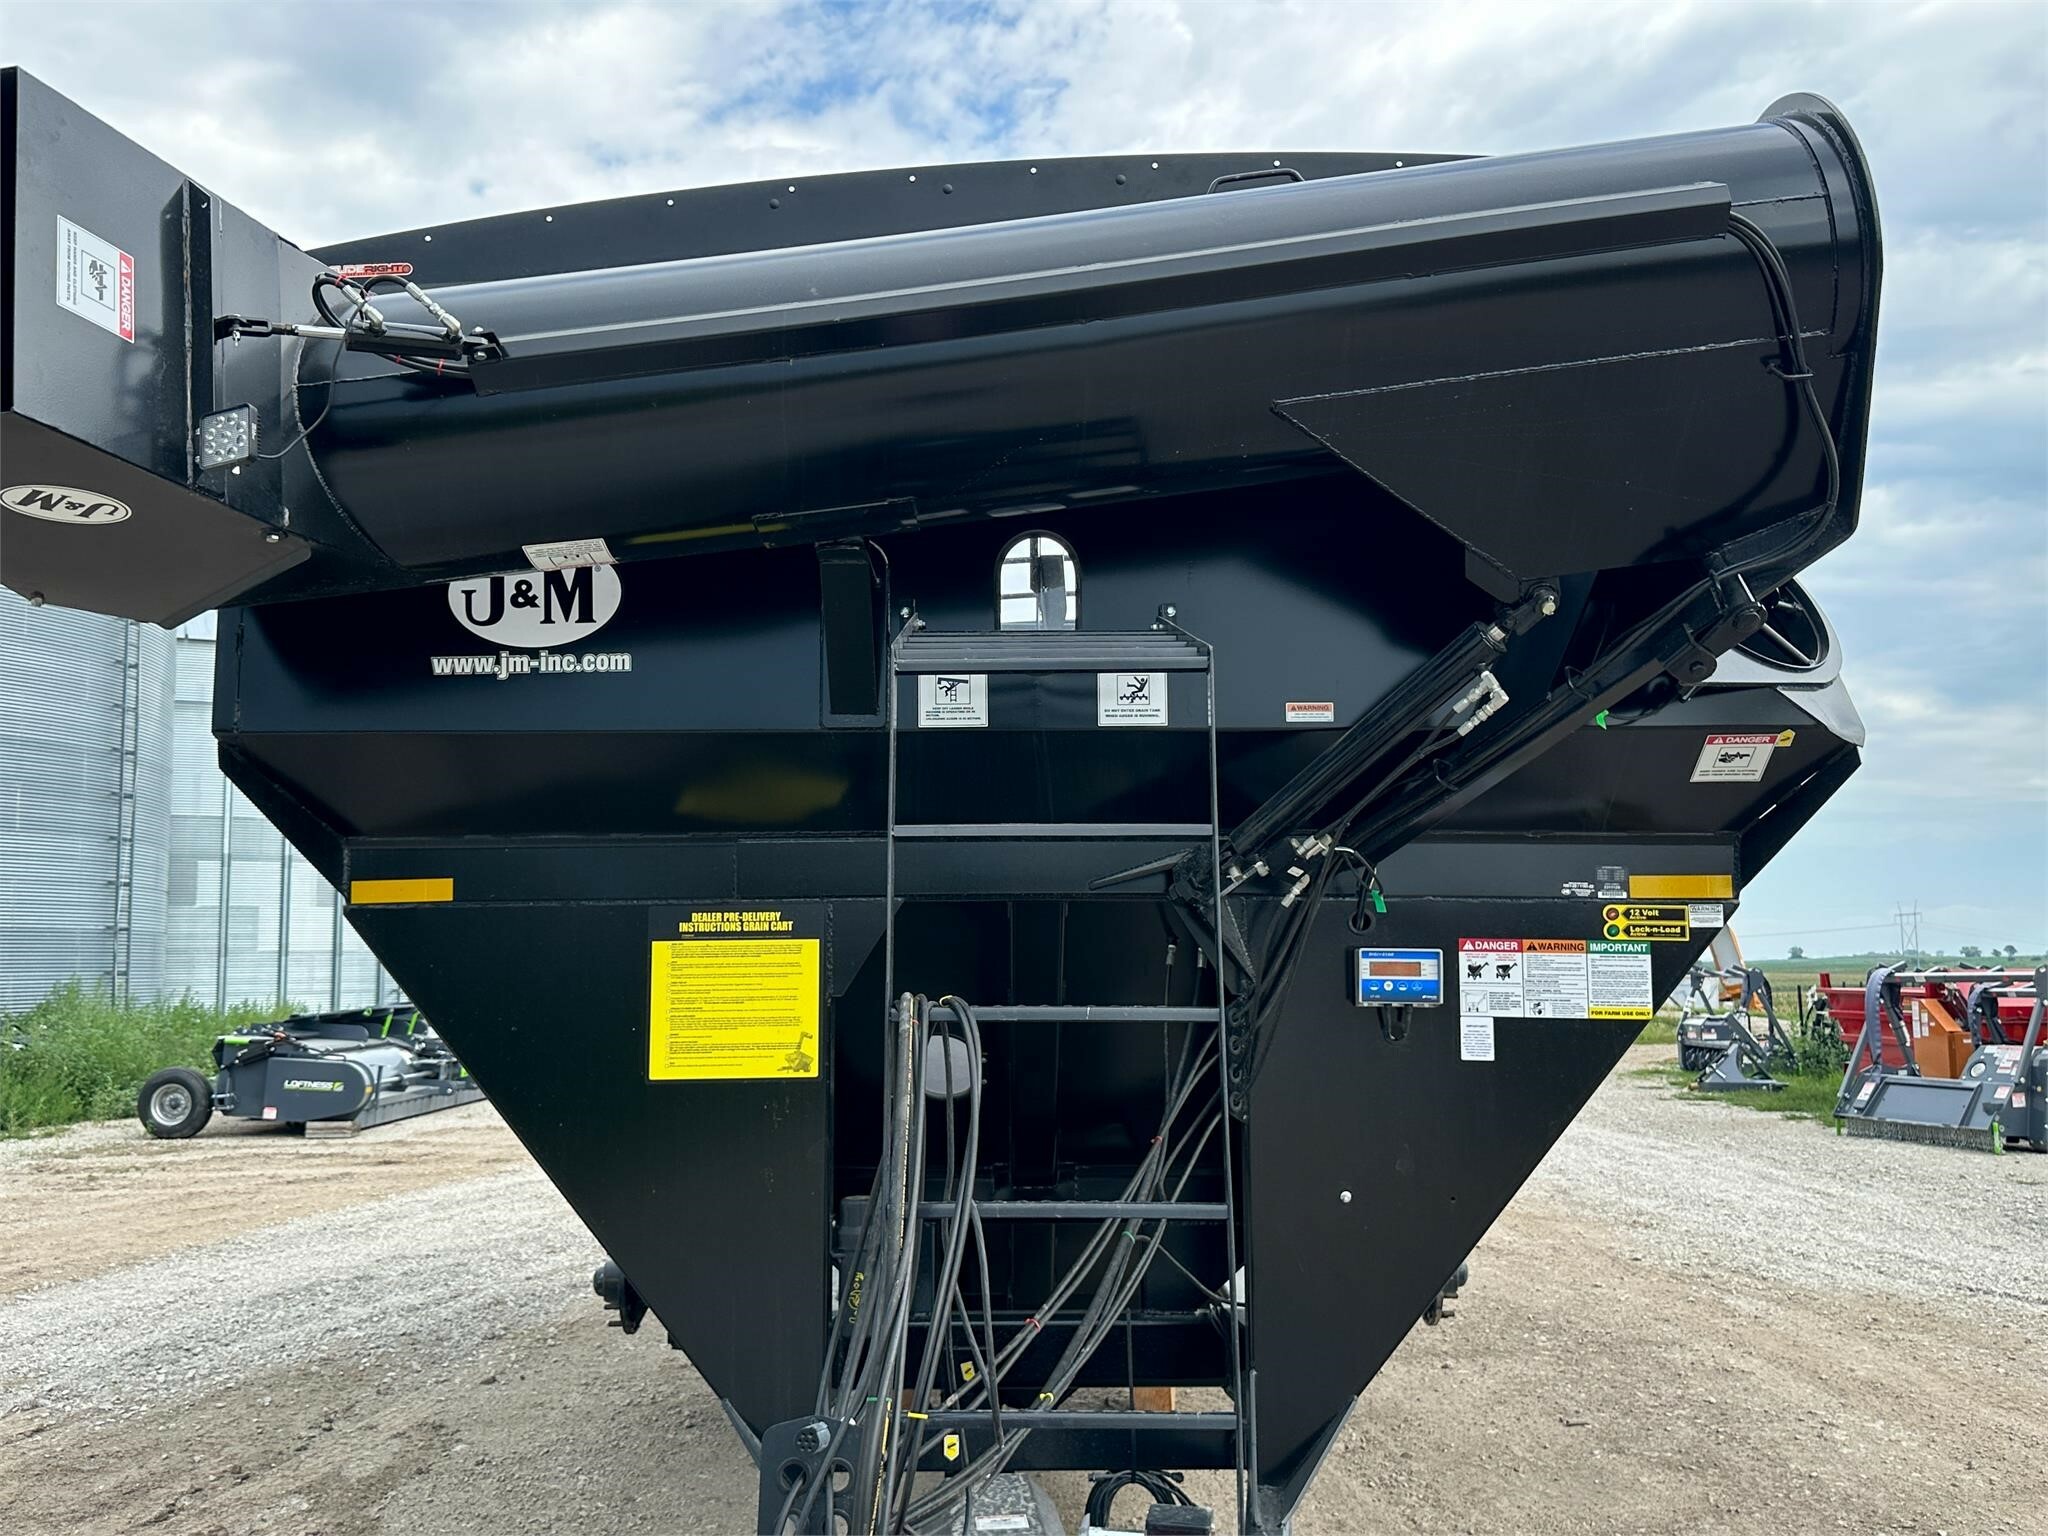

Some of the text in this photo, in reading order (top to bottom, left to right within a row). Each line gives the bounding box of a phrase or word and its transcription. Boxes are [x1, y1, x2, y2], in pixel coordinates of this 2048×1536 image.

[121, 275, 132, 330] DANGER
[11, 488, 120, 519] J&M
[431, 650, 633, 681] www.jm-inc.com
[1725, 736, 1770, 744] DANGER
[691, 911, 781, 922] DEALER PRE-DELIVERY
[679, 921, 794, 932] INSTRUCTIONS GRAIN CART
[1474, 941, 1518, 950] DANGER
[1537, 942, 1585, 951] WARNING
[1589, 943, 1648, 952] IMPORTANT
[283, 1079, 334, 1089] LOFTNESS
